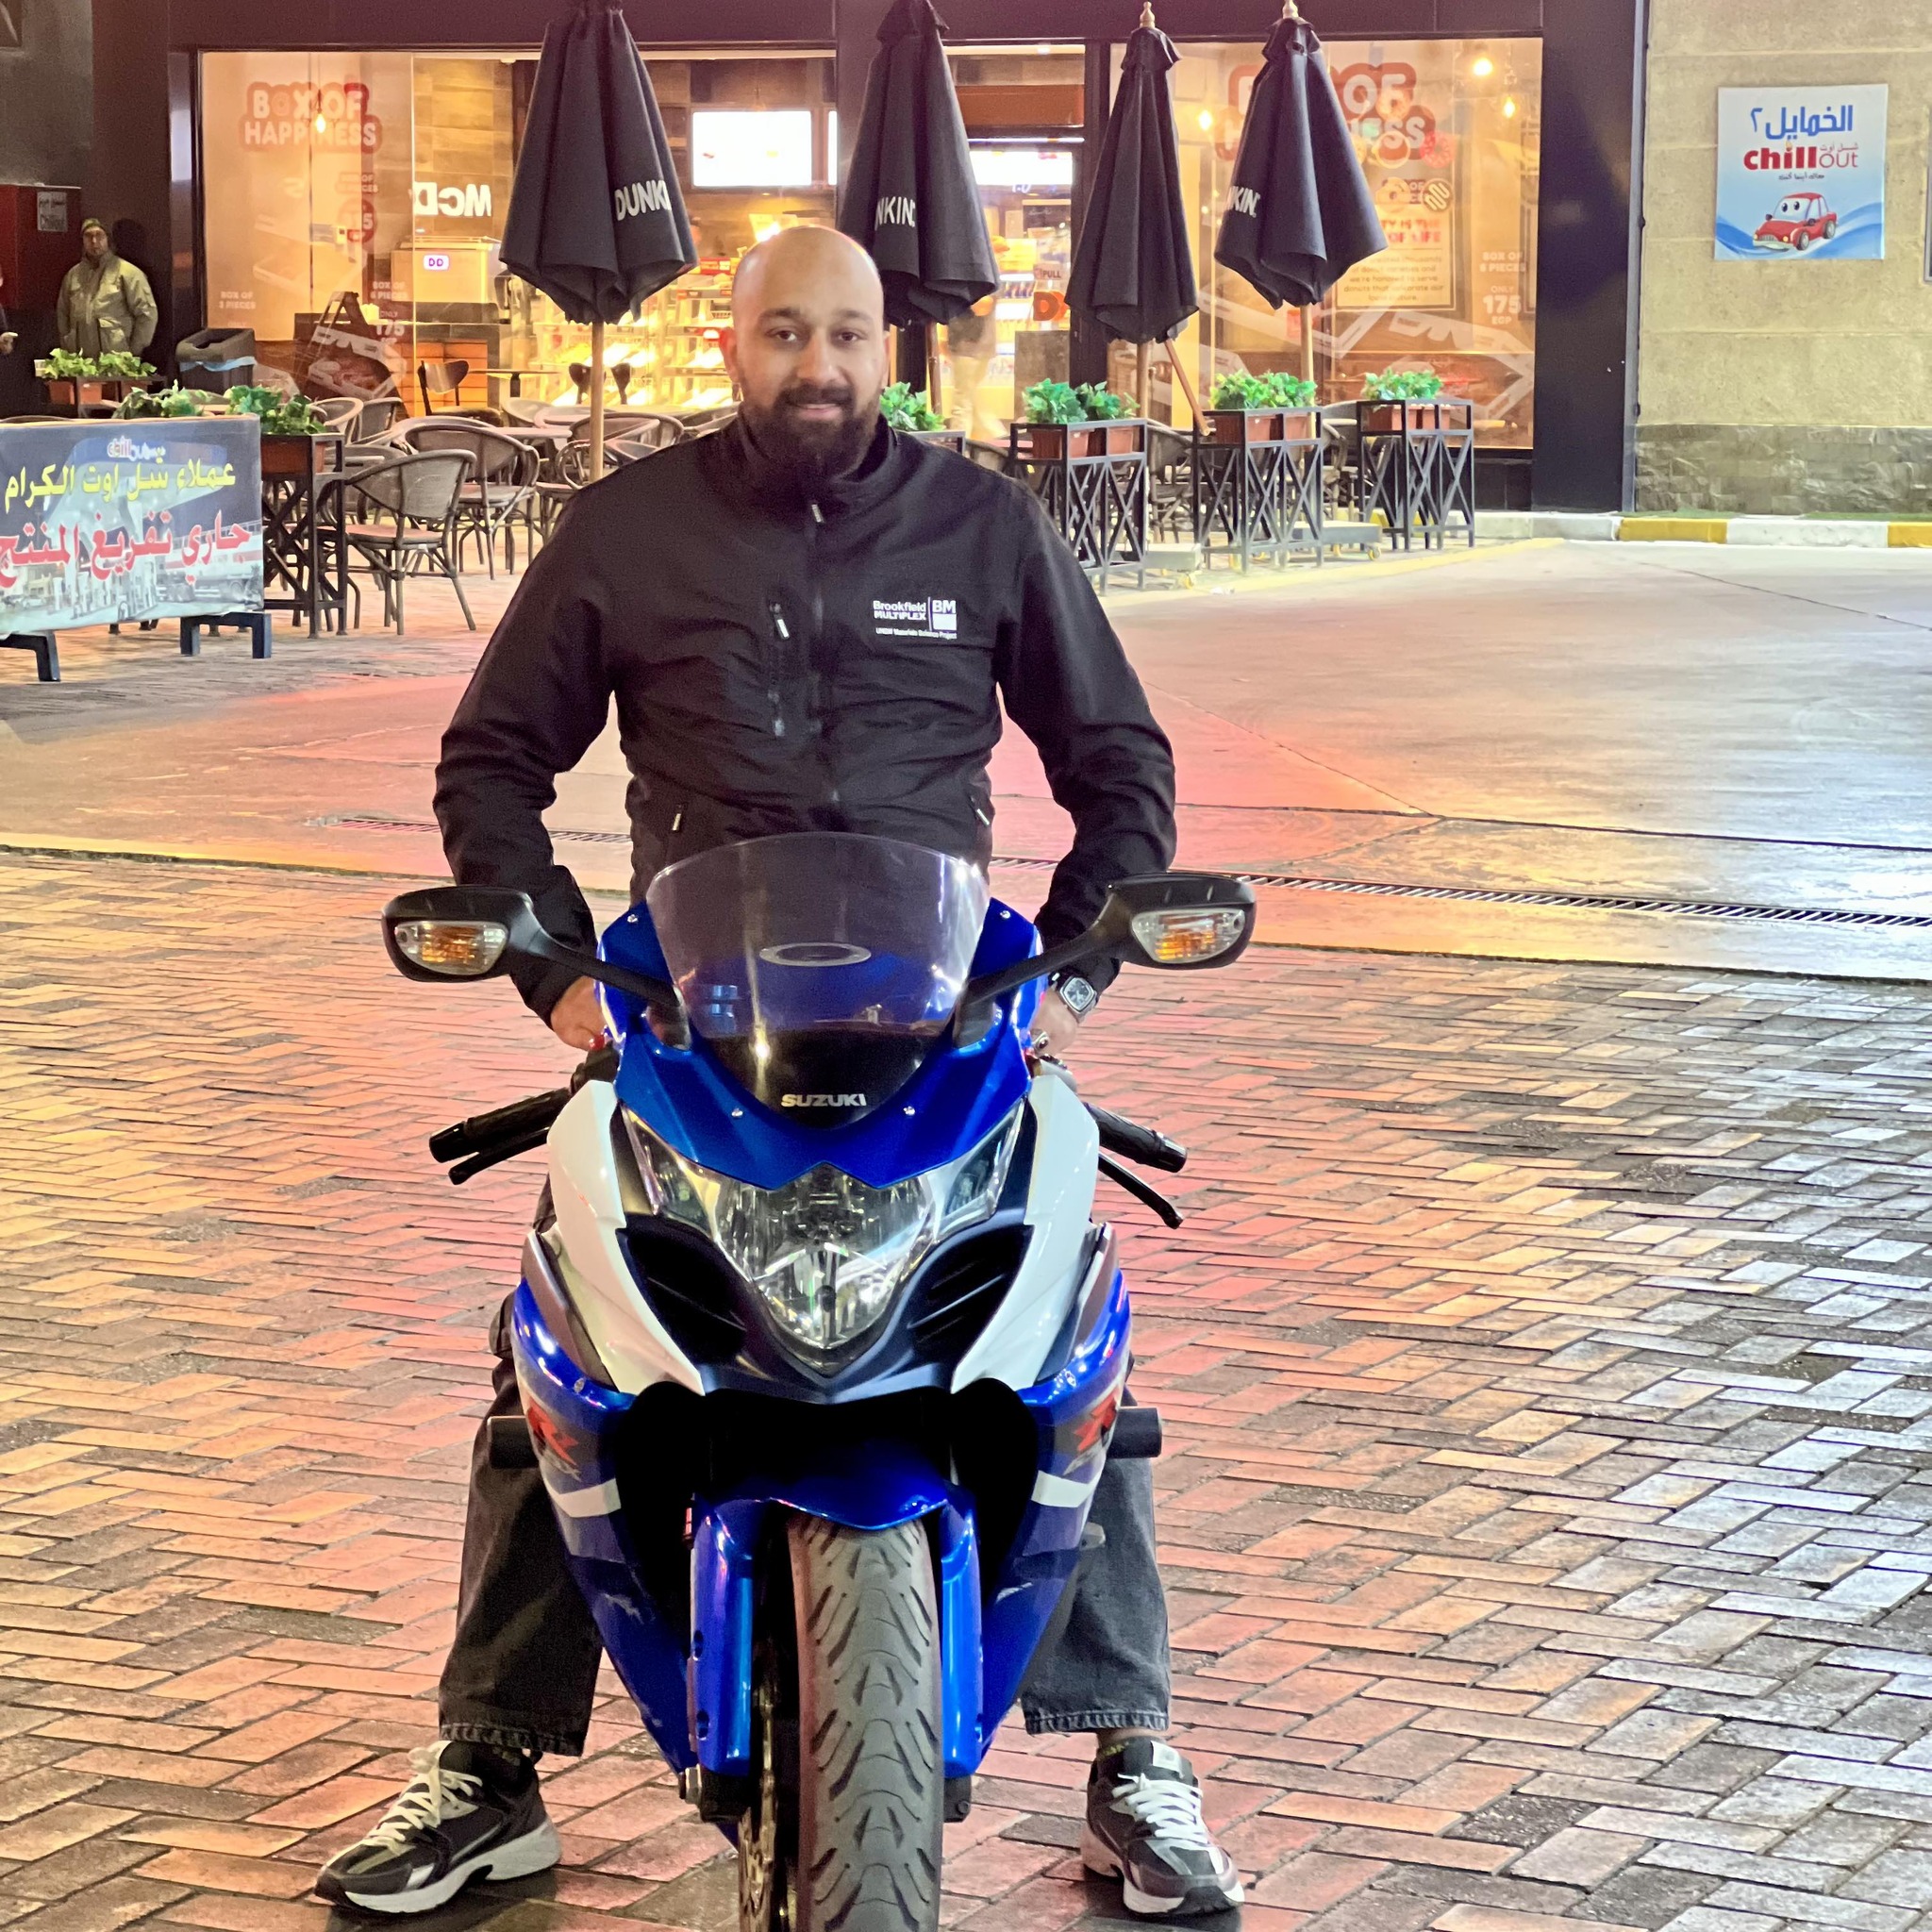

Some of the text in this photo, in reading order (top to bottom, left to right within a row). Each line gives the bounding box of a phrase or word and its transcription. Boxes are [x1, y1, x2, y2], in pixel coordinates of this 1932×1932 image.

[322, 90, 362, 120] OF
[244, 120, 376, 147] HAPPINESS
[1765, 105, 1854, 141] الخمايل
[1743, 144, 1817, 171] chill
[1042, 270, 1061, 278] PULL
[1482, 294, 1523, 314] 175
[82, 463, 119, 503] اوت
[176, 458, 236, 491] عملاء
[4, 463, 75, 514] الكرام
[92, 510, 173, 581] تفريغ
[181, 509, 253, 586] جاري
[873, 600, 926, 612] Brookfield
[874, 610, 926, 621] MULTIPLEX
[932, 599, 957, 614] BM
[781, 1092, 867, 1108] SUZUKI
